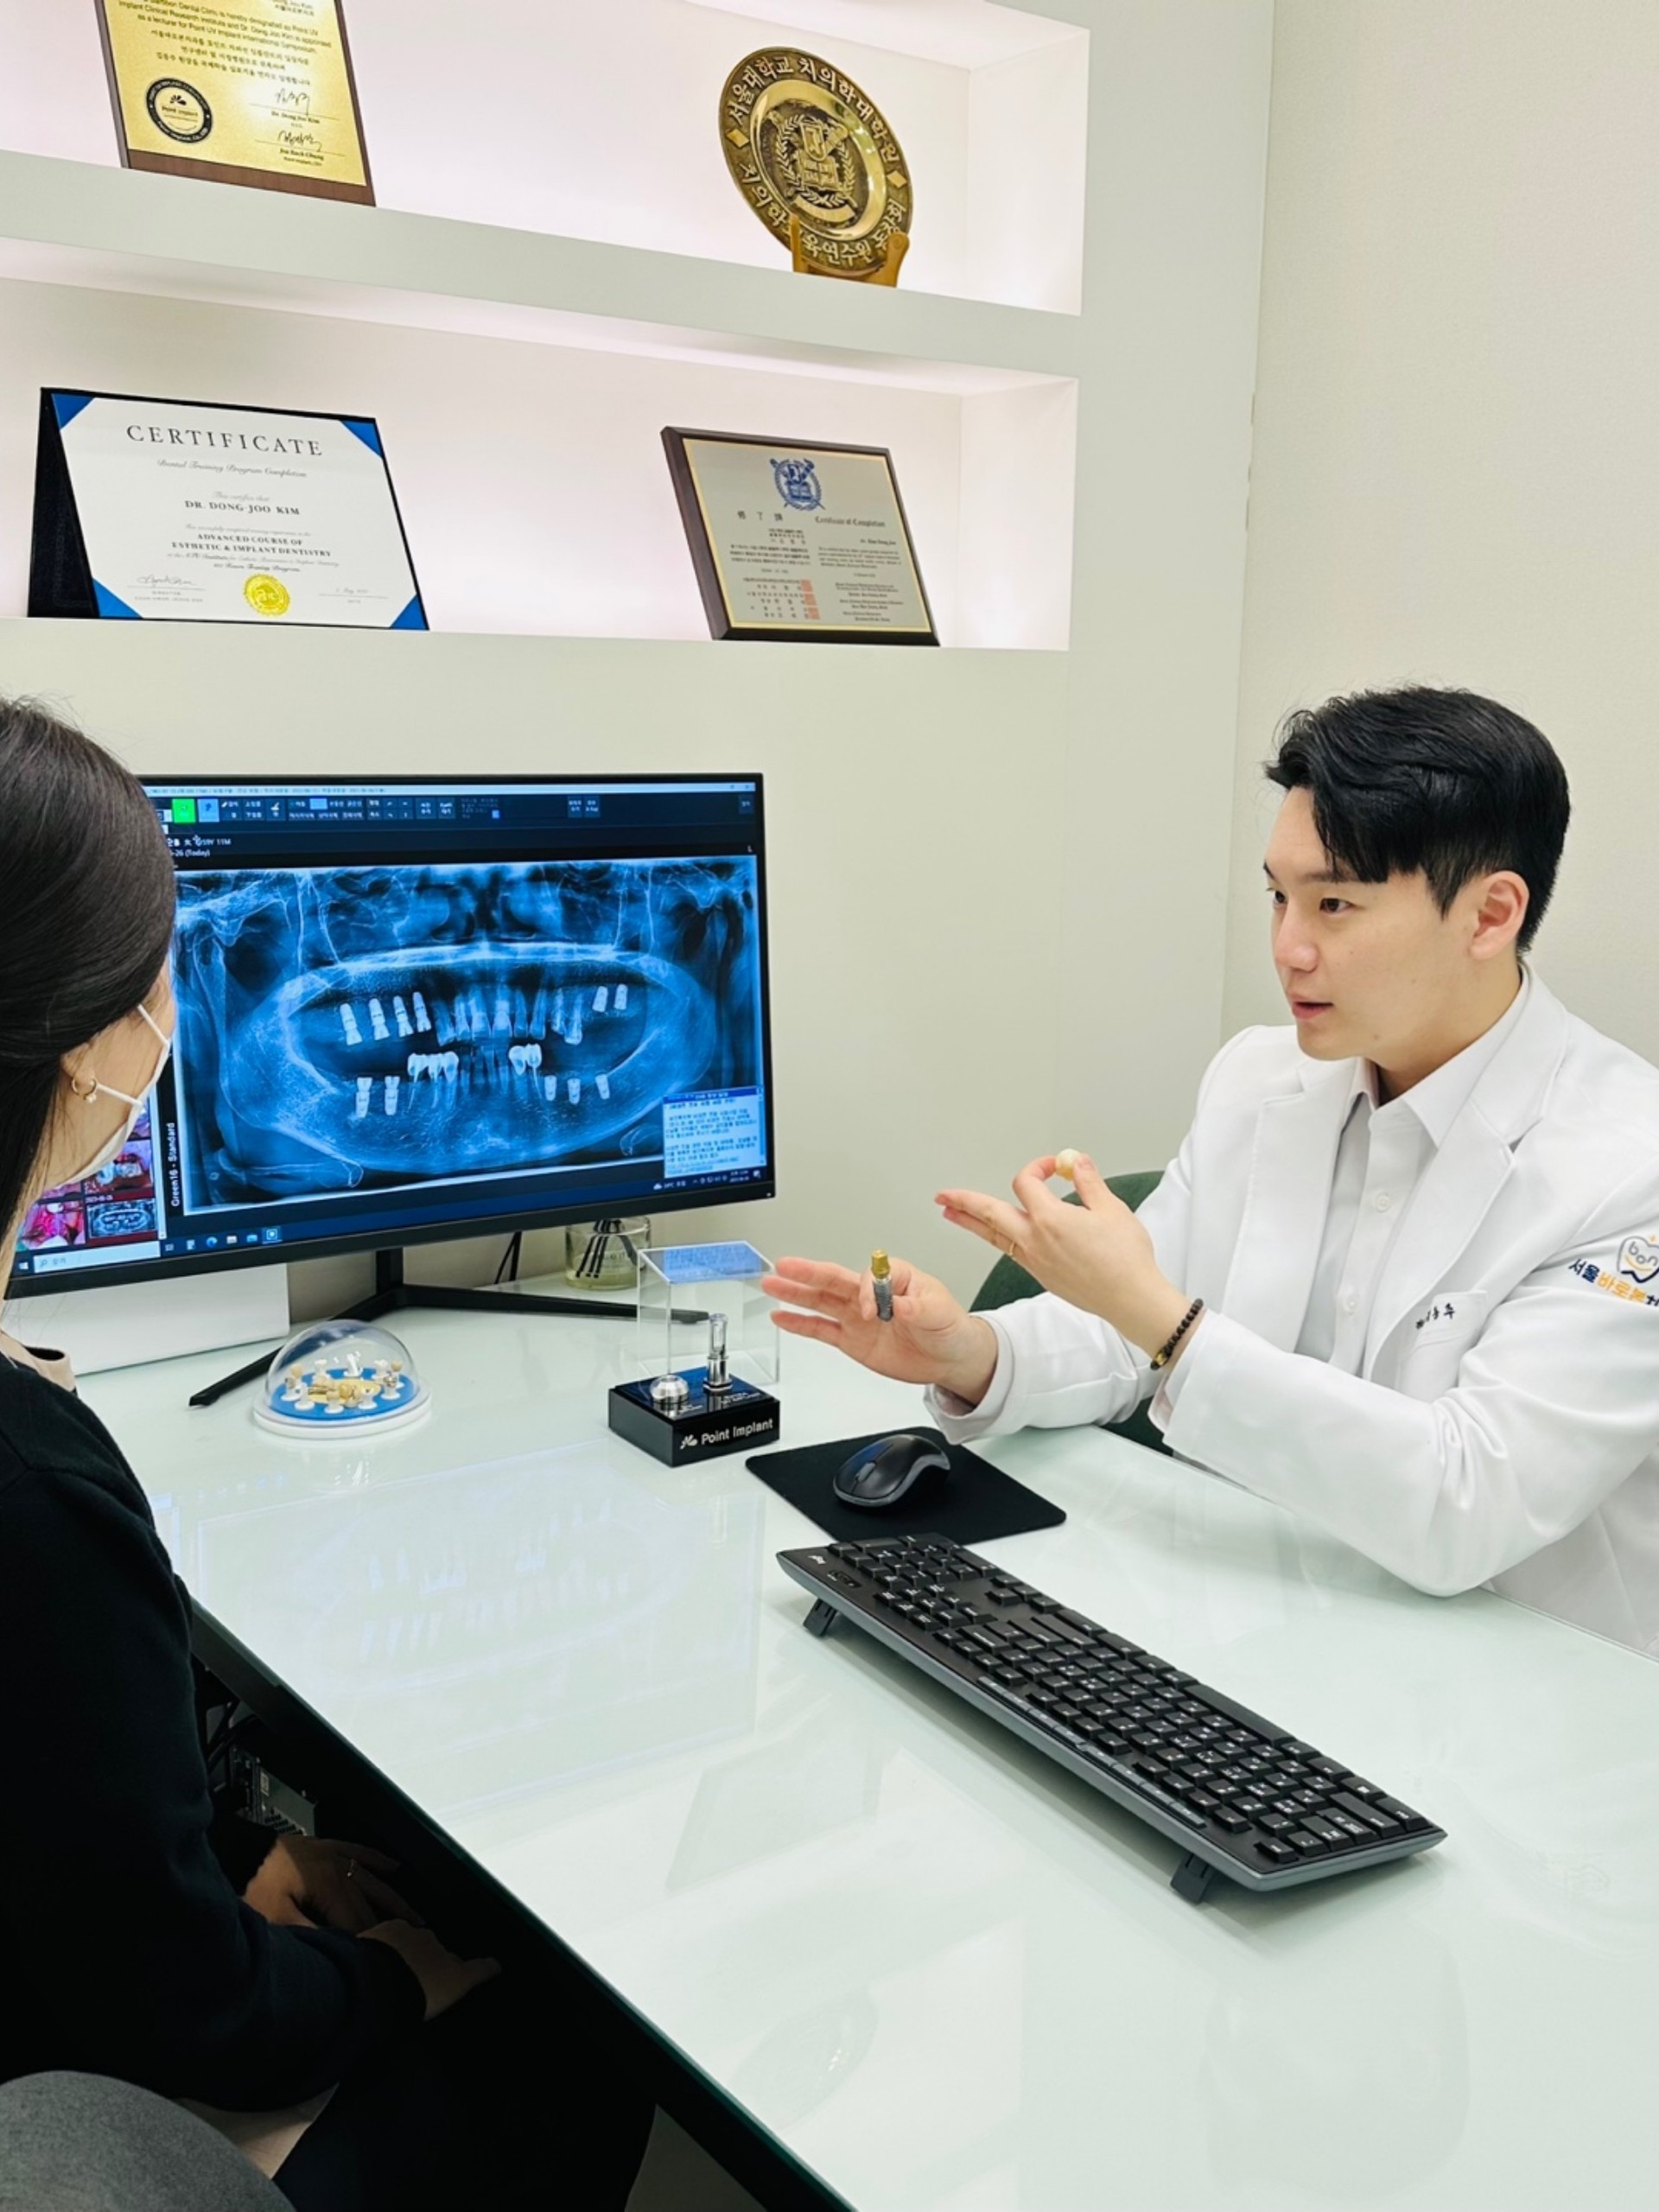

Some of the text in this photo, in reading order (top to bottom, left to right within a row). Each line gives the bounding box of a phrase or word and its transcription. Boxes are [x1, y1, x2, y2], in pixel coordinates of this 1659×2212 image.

[728, 56, 900, 163] 서울대학교 치의학대학원
[741, 162, 874, 265] 치의학육연수원
[126, 424, 322, 456] CERTIFICATE
[276, 506, 300, 516] KIM
[171, 542, 221, 551] ESTHETIC
[233, 544, 276, 554] IMPLANT
[277, 547, 331, 557] DENTISTRY
[197, 533, 249, 543] ADVANCED
[251, 537, 288, 545] COURSE
[166, 1122, 178, 1161] Standard
[701, 1418, 773, 1445] Point Implant
